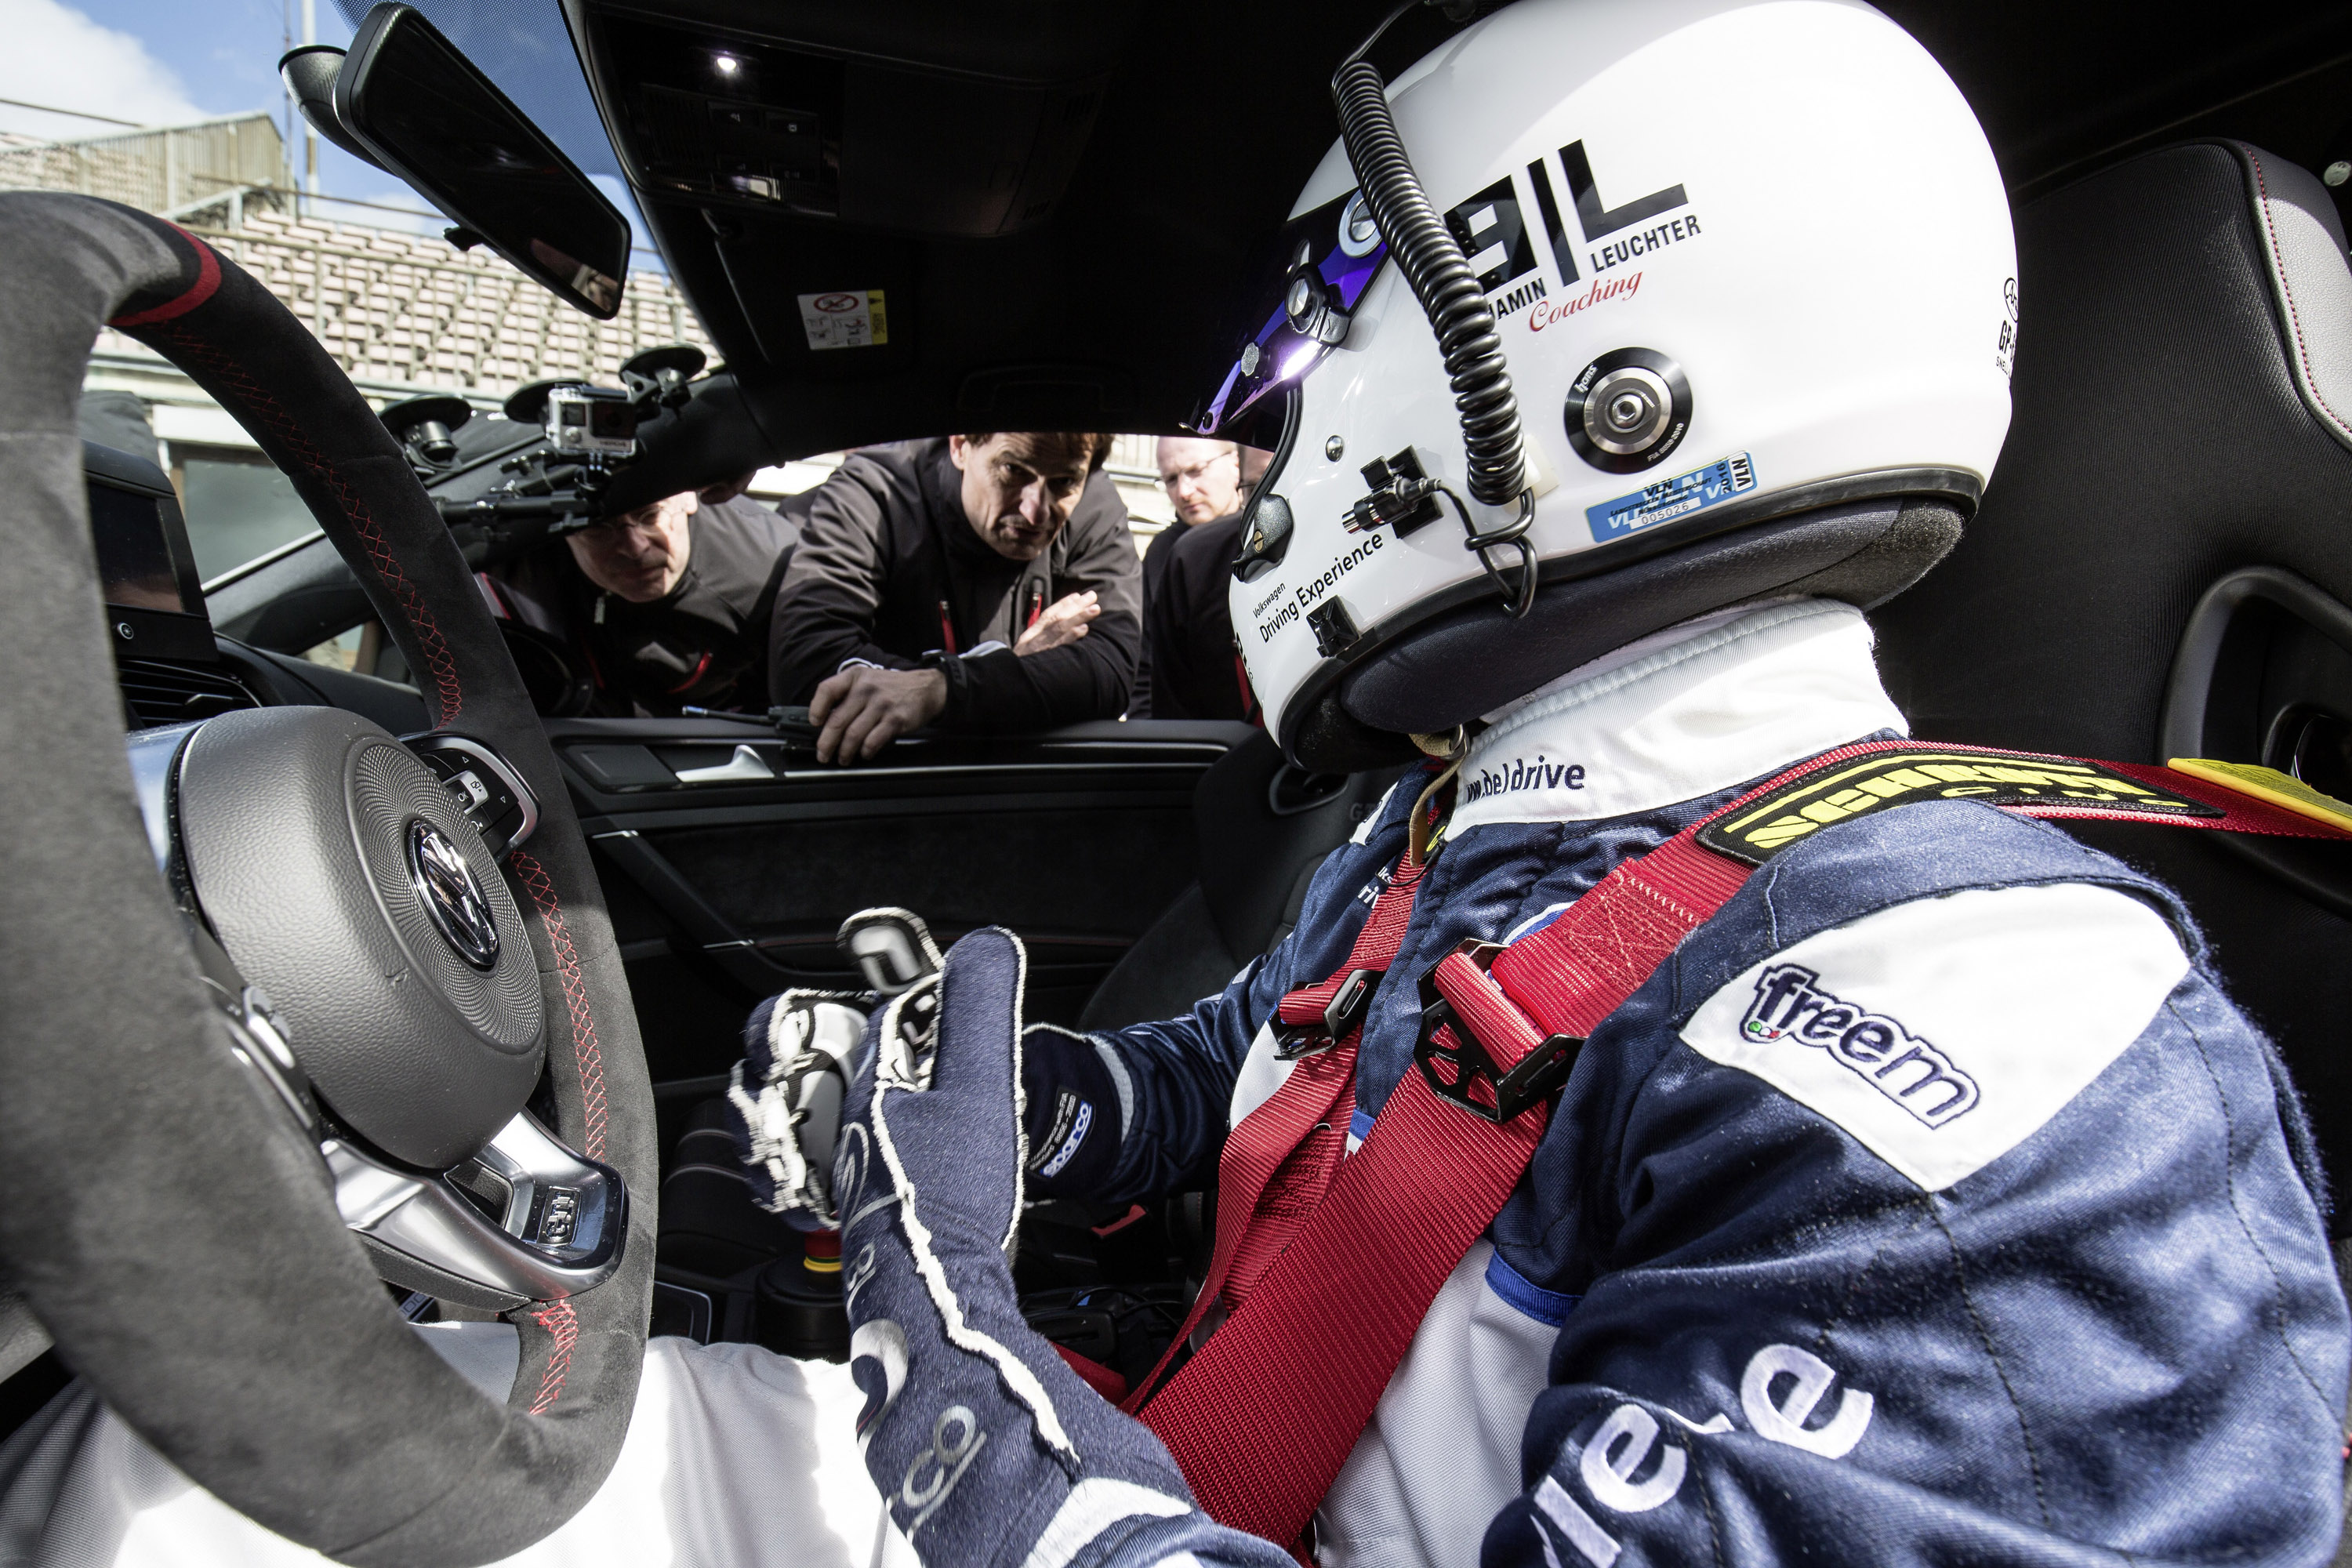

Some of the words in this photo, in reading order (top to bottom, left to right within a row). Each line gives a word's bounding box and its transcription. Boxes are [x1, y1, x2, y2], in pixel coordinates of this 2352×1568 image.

[1591, 214, 1702, 274] LEUCHTER
[1529, 271, 1643, 332] Coaching
[1731, 458, 1752, 488] VLN
[1641, 503, 1690, 524] 005026
[1252, 582, 1287, 619] Volkswagen
[1259, 601, 1300, 644] Driving
[1296, 533, 1385, 608] Experience
[457, 790, 470, 802] OK
[1756, 967, 1973, 1120] freem
[1043, 1102, 1090, 1176] sparco
